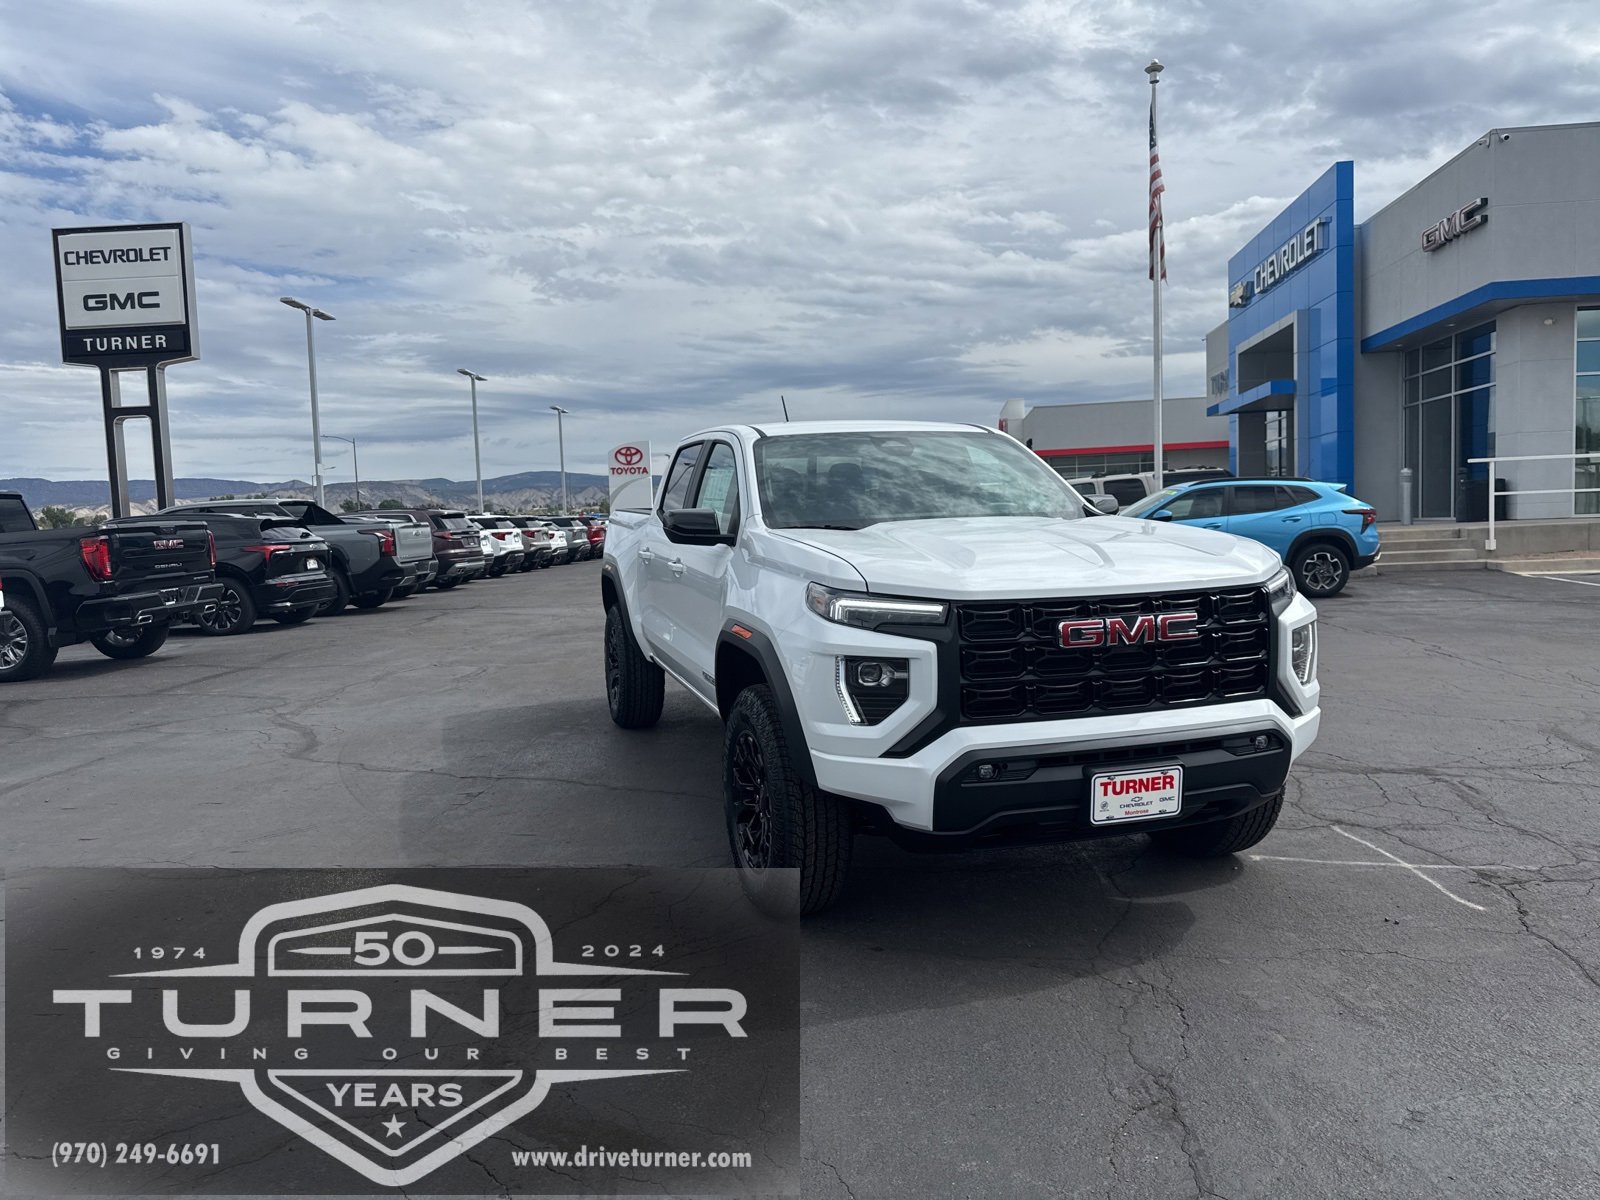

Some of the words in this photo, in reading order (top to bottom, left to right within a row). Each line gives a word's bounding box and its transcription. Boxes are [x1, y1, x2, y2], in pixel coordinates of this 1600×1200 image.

[1421, 197, 1489, 252] GMC
[63, 246, 171, 266] CHEVROLET
[1254, 216, 1328, 294] CHEVROLET
[82, 291, 161, 312] GMC
[83, 334, 167, 352] TURNER
[610, 466, 649, 475] TOYOTA
[1058, 612, 1199, 648] GMC
[1099, 774, 1175, 797] TURNER
[1119, 800, 1154, 809] CHEVROLET
[1124, 808, 1149, 816] Montrose
